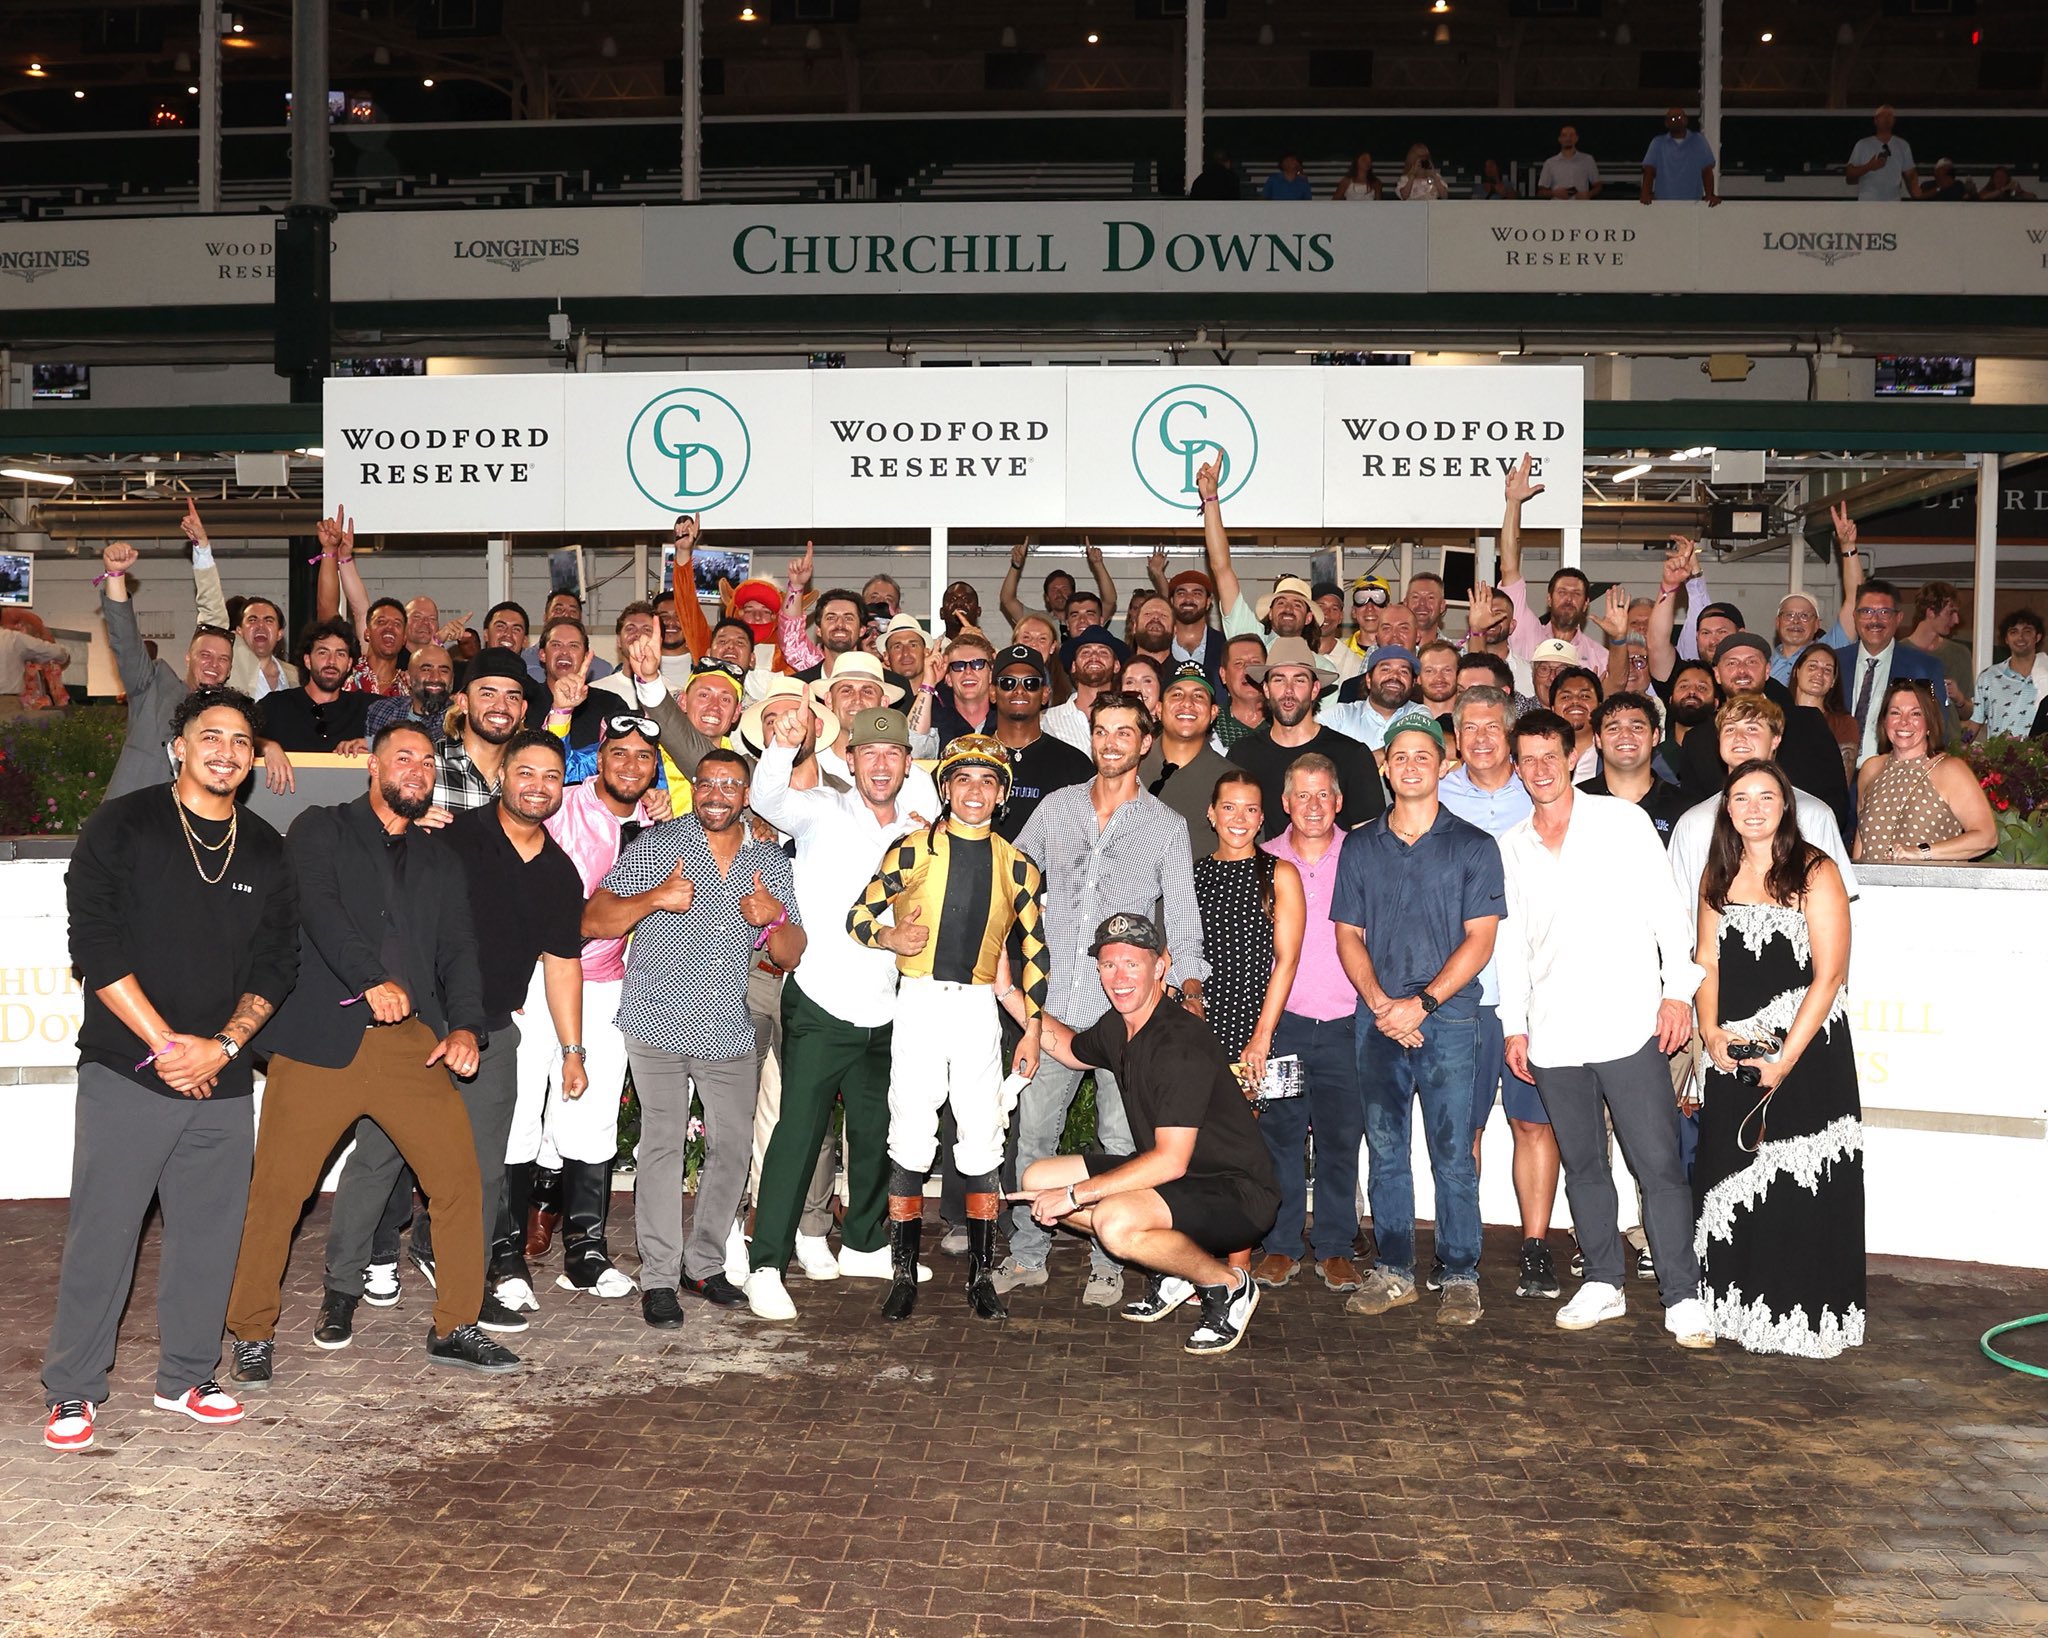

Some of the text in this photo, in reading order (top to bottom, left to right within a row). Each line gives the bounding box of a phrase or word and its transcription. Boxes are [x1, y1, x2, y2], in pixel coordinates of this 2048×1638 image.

[1491, 226, 1636, 243] WOODFORD
[1763, 232, 1898, 252] LONGINES
[454, 238, 580, 258] LONGINES
[733, 221, 1335, 275] CHURCHILL DOWNS
[1506, 250, 1624, 266] RESERVE
[0, 250, 90, 268] NGINES
[218, 264, 275, 279] RESE
[340, 427, 549, 451] WOODFORD
[830, 419, 1049, 443] WOODFORD
[1342, 418, 1565, 442] WOODFORD
[360, 462, 530, 485] RESERVE
[851, 455, 1028, 478] RESERVE
